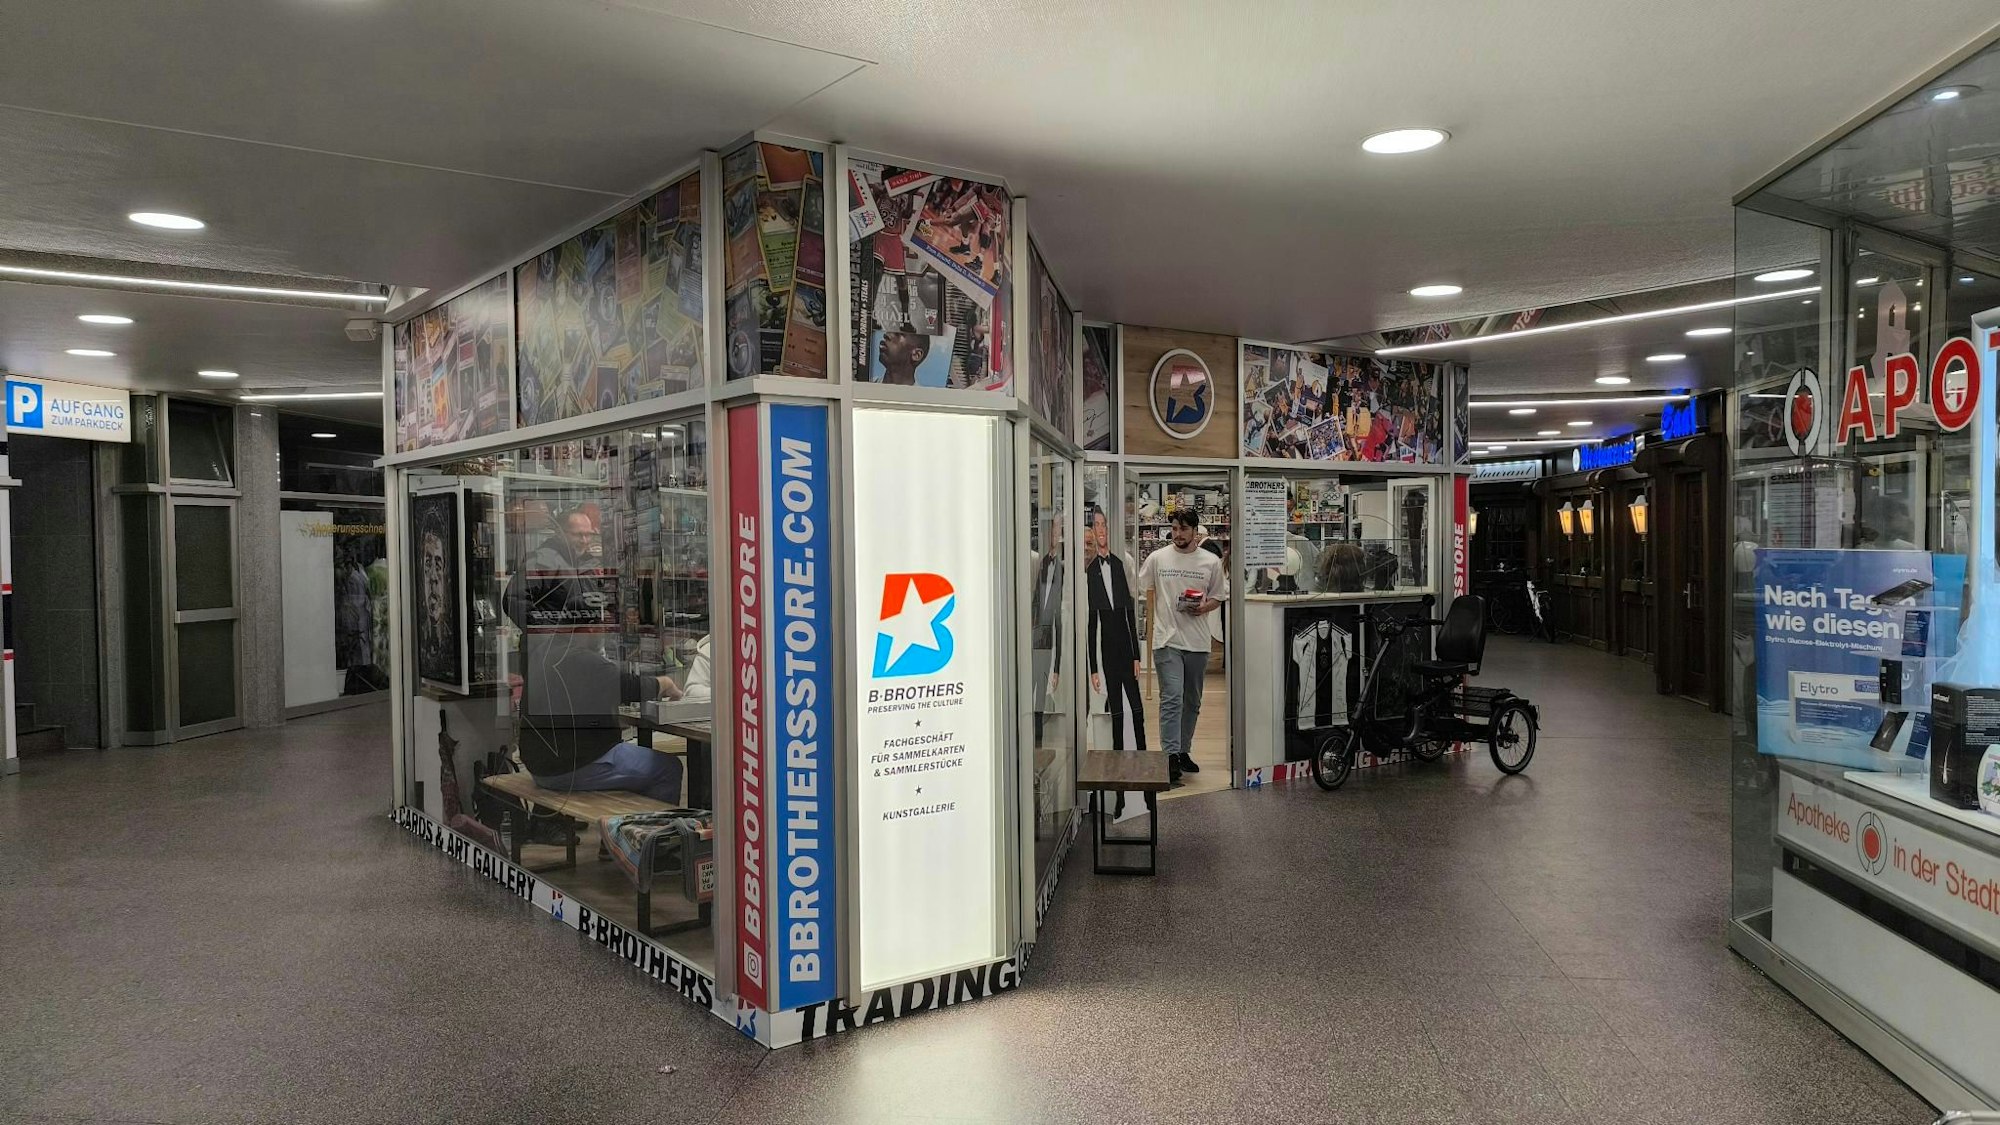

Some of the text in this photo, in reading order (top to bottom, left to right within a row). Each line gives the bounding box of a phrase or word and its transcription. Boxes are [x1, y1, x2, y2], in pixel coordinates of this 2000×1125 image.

[858, 280, 869, 366] MICHAEL JORDAN STEALS
[1835, 329, 2000, 446] APO
[13, 385, 38, 424] P
[51, 398, 124, 419] AUFGANG
[51, 415, 123, 431] ZUM PARKDECK
[1473, 465, 1533, 479] staurant
[1764, 585, 1916, 616] Nach Tagn
[1765, 610, 1806, 632] wie
[1800, 681, 1839, 696] Elytro
[780, 436, 821, 983] BBROTHERSSTORE.COM
[867, 697, 964, 714] PRESERVING THE CULTURE
[738, 512, 762, 940] BBROTHERSSTORE
[883, 732, 954, 748] FACHGESCHÄFT
[871, 745, 965, 764] FÜR SAMMELKARTEN
[873, 758, 963, 777] & SAMMLERSTÜCKE
[882, 802, 956, 821] KUNSTGALLERIE
[400, 805, 433, 843] CARDS
[435, 827, 444, 850] &
[448, 833, 471, 864] ART
[473, 846, 536, 903] GALLERY
[1787, 792, 2000, 915] Apotheke in der Stadt
[795, 957, 1016, 1042] TRADING
